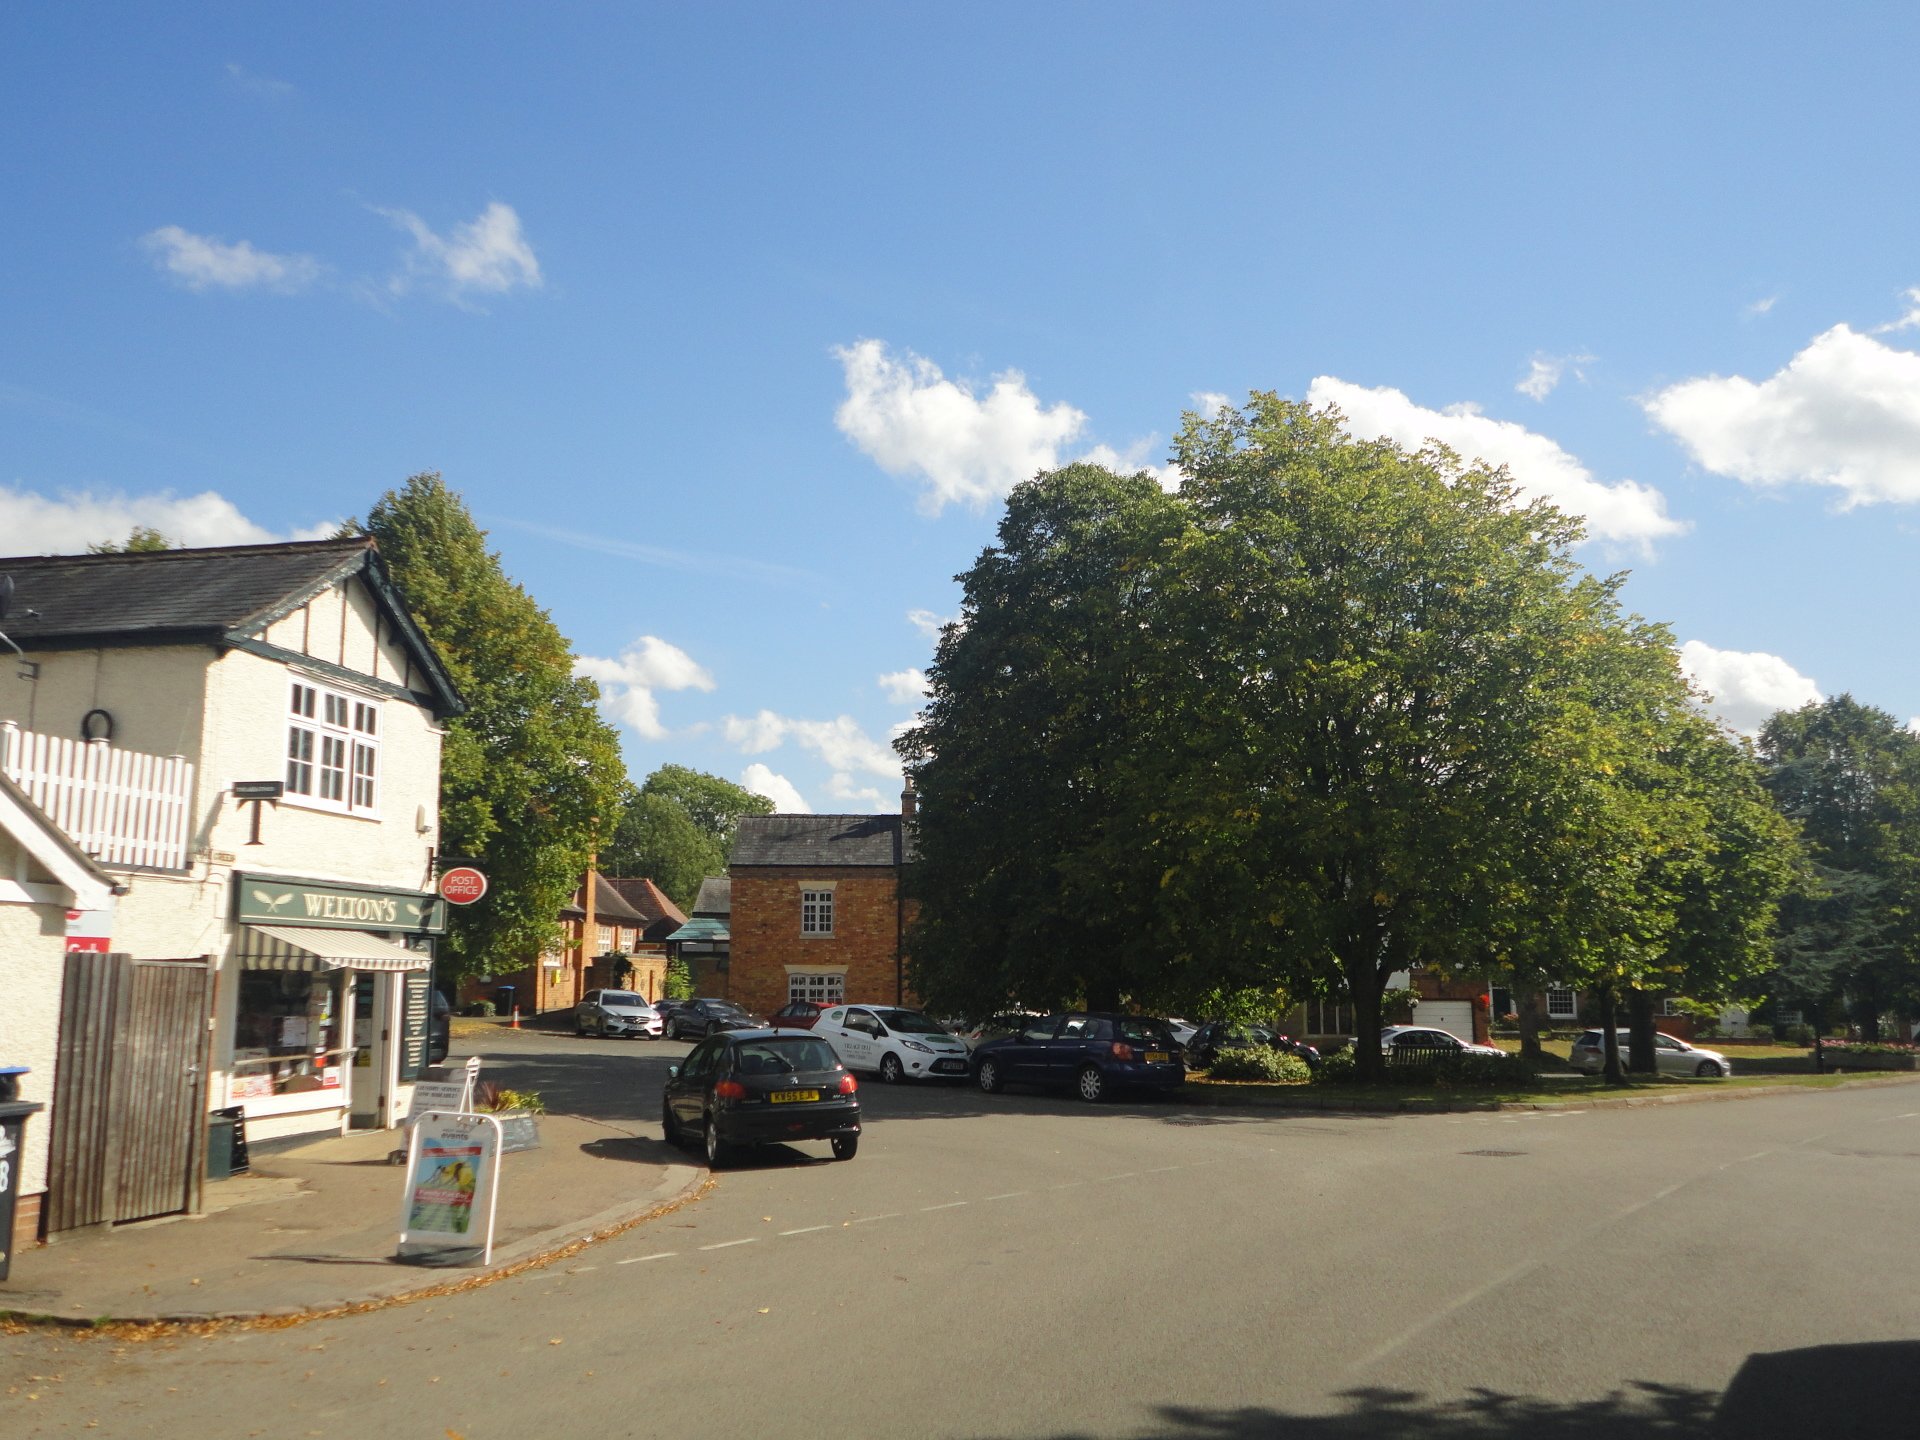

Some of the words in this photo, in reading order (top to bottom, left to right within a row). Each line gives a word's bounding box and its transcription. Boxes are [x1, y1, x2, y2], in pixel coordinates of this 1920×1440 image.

[450, 876, 477, 885] POST
[444, 885, 479, 895] OFFICE
[303, 893, 398, 922] WELTON'S
